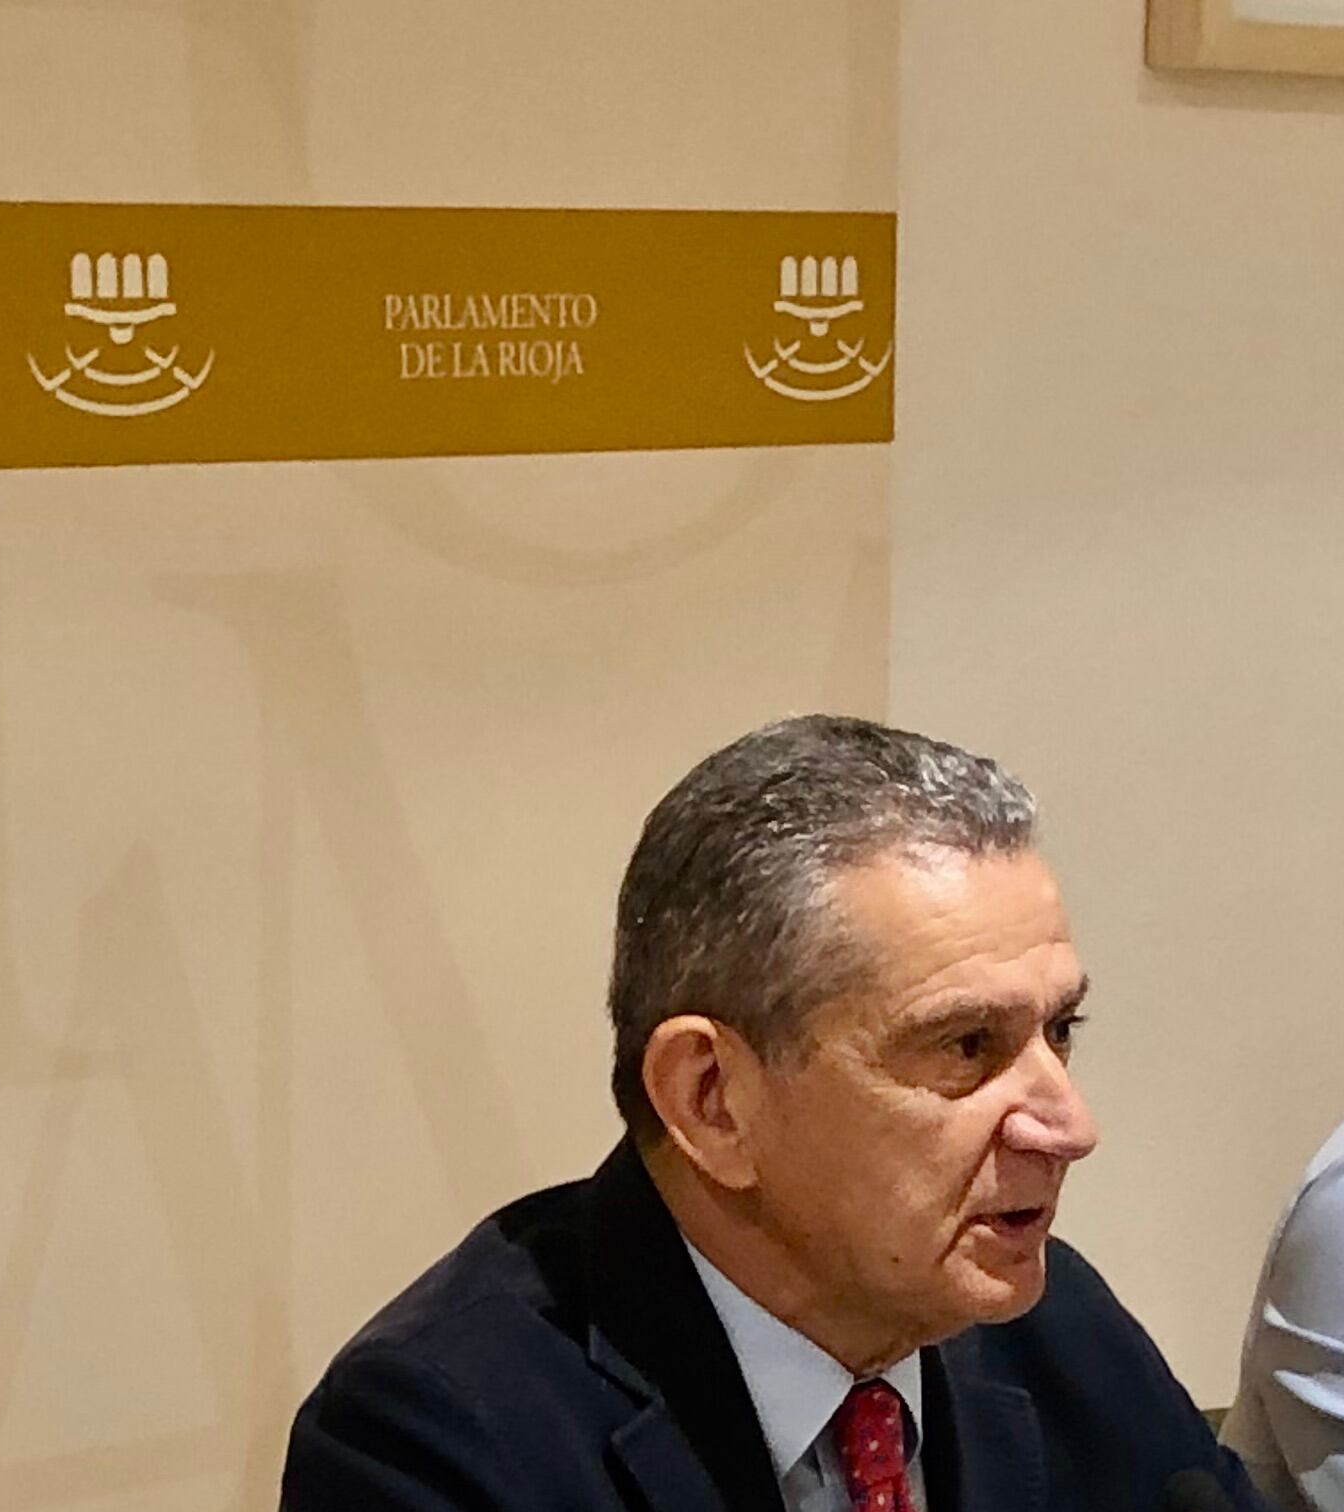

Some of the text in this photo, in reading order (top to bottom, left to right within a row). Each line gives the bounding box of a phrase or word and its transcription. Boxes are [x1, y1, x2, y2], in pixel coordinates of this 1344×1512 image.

[385, 293, 598, 330] PARLAMENTO
[400, 340, 584, 384] DE LA RIOJA
